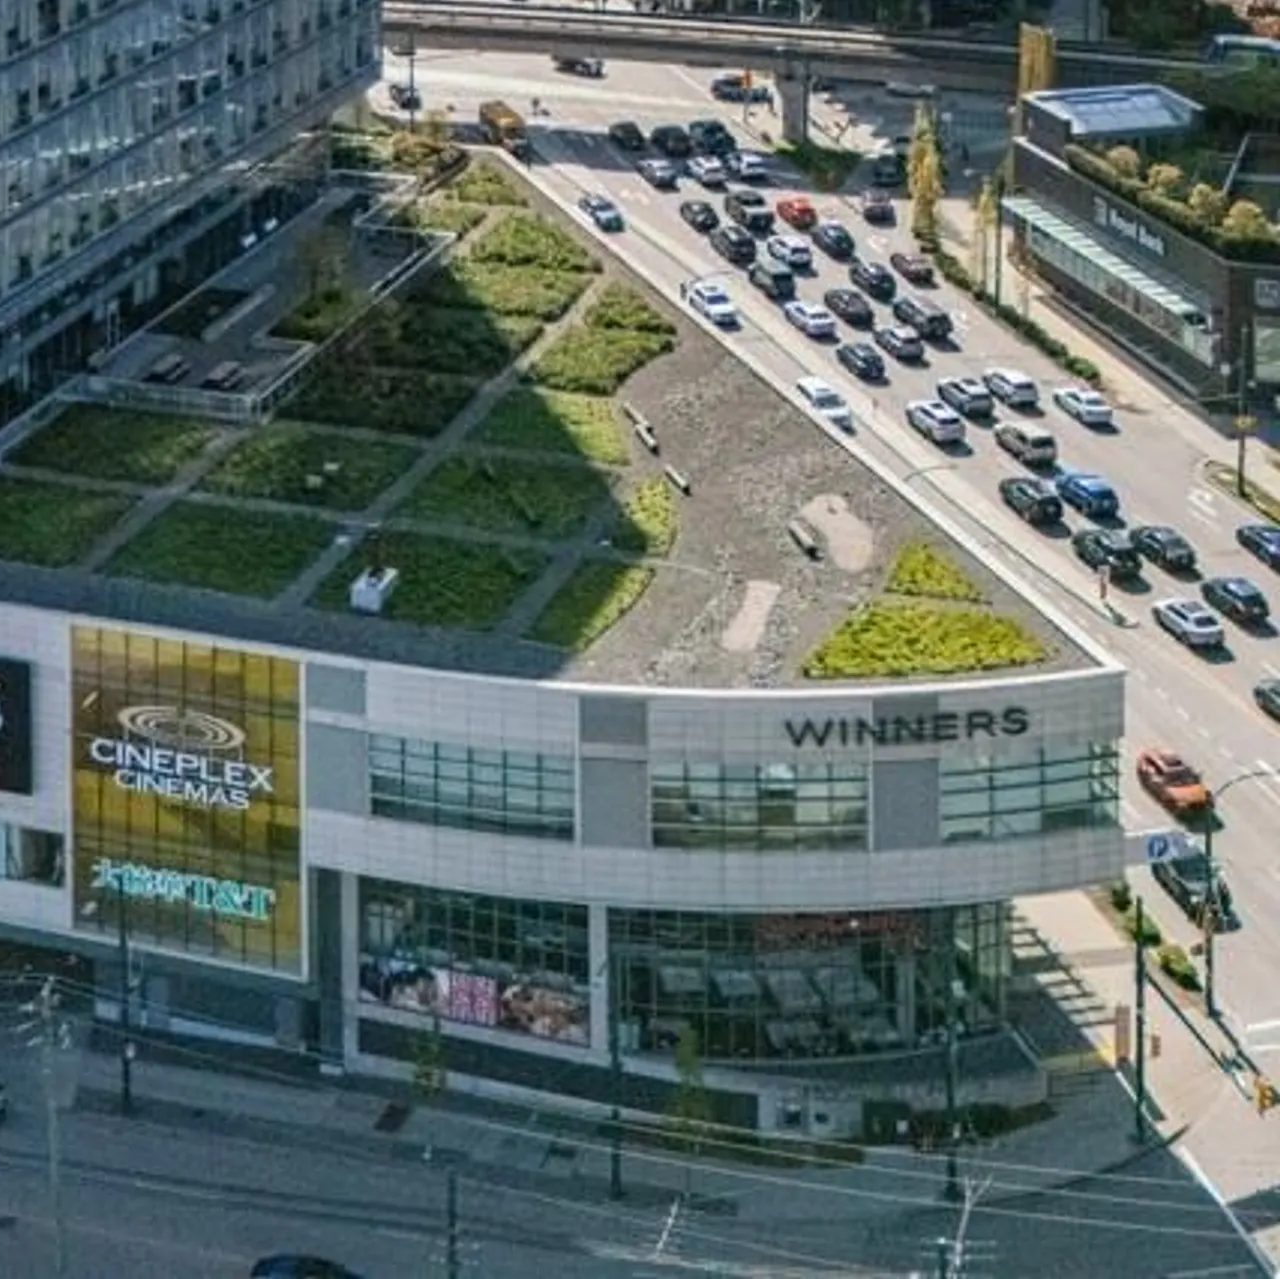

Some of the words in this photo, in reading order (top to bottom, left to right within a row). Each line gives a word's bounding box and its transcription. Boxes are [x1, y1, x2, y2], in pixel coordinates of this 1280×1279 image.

[785, 705, 1029, 748] WINNERS
[91, 738, 273, 792] CINEPLEX
[115, 770, 250, 810] CINEMAS
